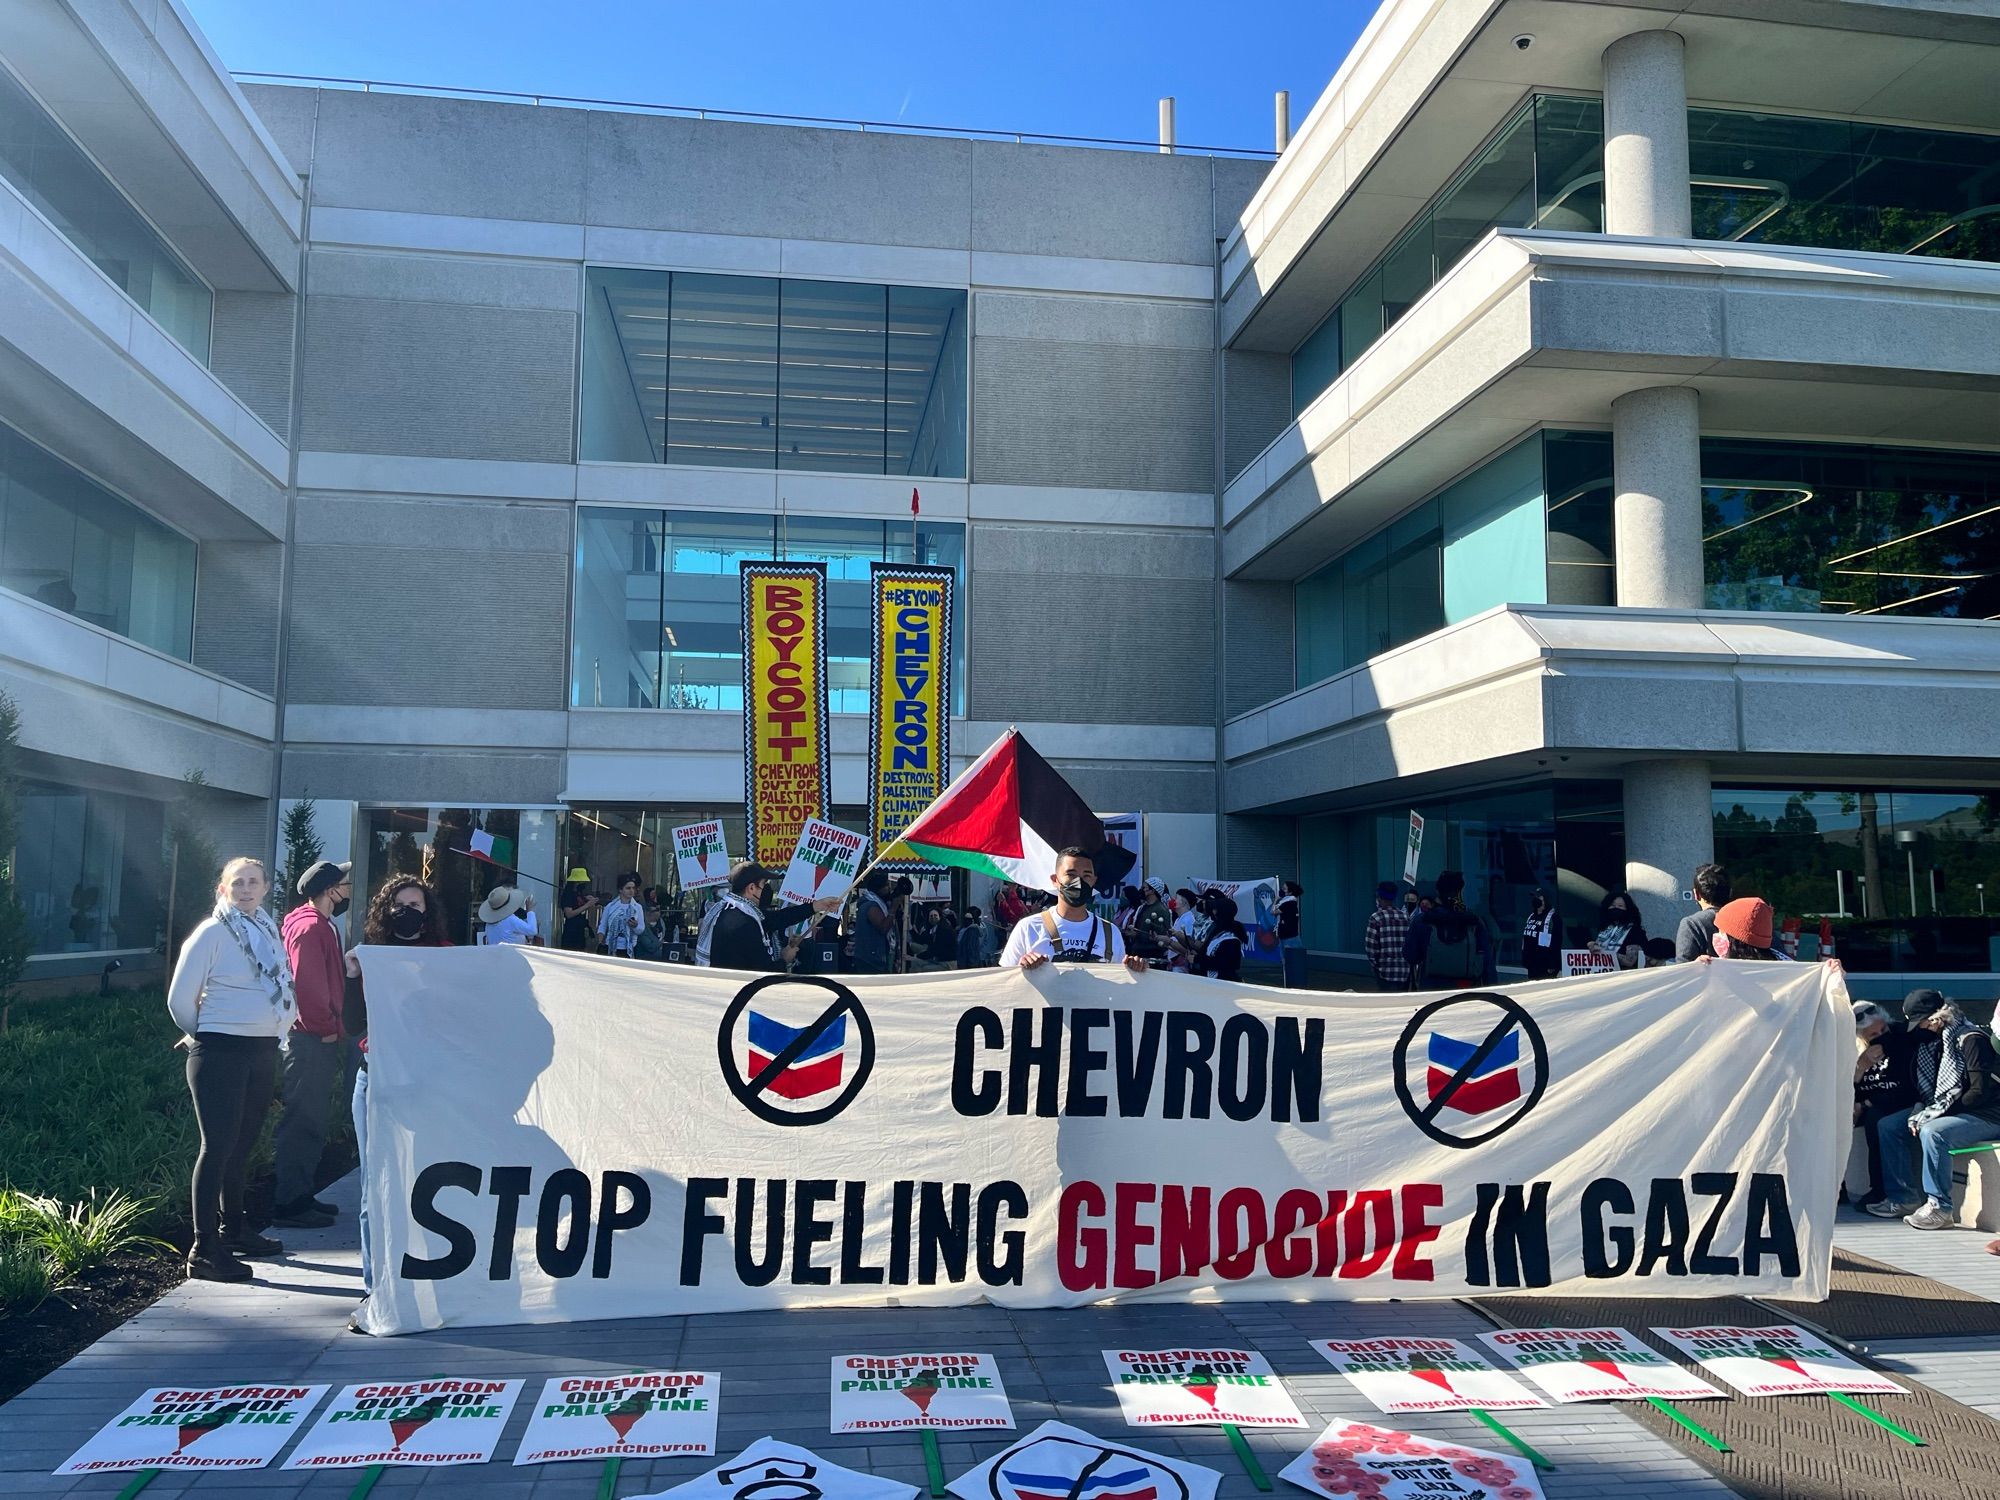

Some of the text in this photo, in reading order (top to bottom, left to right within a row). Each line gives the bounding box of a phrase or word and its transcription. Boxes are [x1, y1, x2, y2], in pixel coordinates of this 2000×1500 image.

[885, 589, 940, 607] #BEYOND
[765, 585, 807, 762] BOYCOTT
[893, 609, 930, 769] CHEVRON
[759, 764, 817, 779] CHEVRON
[883, 772, 934, 783] DESTROYS
[762, 780, 814, 790] OUT OF
[760, 791, 818, 804] PALESTINE
[762, 806, 814, 822] STOP
[677, 823, 718, 839] CHEVRON
[809, 823, 861, 850] CHEVRON
[682, 834, 717, 848] OUT OF
[678, 842, 724, 859] PALETINE
[808, 837, 854, 861] OUT OF
[797, 847, 854, 877] PALETINE
[1567, 953, 1614, 967] CHEVRON
[950, 1006, 1325, 1123] CHEVRON
[401, 1161, 1800, 1292] STOP FUELING GENOCIDE IN GAZA
[1494, 1330, 1623, 1344] CHEVRON
[1669, 1329, 1799, 1339] CHEVRON
[1327, 1340, 1456, 1352] CHEVRON
[1516, 1340, 1627, 1352] OUT OF
[1693, 1338, 1803, 1349] OUT OF
[847, 1356, 979, 1368] CHEVRON
[1119, 1351, 1251, 1362] CHEVRON
[1348, 1351, 1458, 1362] OUT OF
[858, 1367, 975, 1379] OUT OF
[1133, 1363, 1247, 1374] OUT OF
[560, 1375, 703, 1391] CHEVRON
[841, 1377, 993, 1392] PALESTINE
[1120, 1374, 1272, 1386] PALESTINE
[152, 1388, 310, 1402] CHEVRON
[354, 1383, 506, 1398] CHEVRON
[566, 1387, 694, 1404] OUT OF
[151, 1400, 292, 1414] OUT OF
[355, 1394, 491, 1410] OUT OF
[543, 1400, 708, 1418] PALESTINE
[117, 1412, 298, 1427] PALESTINE
[328, 1406, 502, 1423] PALESTINE
[1136, 1413, 1299, 1424] #BoycottChevron
[842, 1418, 1007, 1429] #BoycottChevron
[296, 1452, 482, 1465] #BoycottChevron
[528, 1444, 706, 1459] #BoycottChevron
[72, 1457, 262, 1470] #BoycottChevron
[1391, 1468, 1454, 1480] OUT OF
[1414, 1481, 1467, 1493] GAZA
